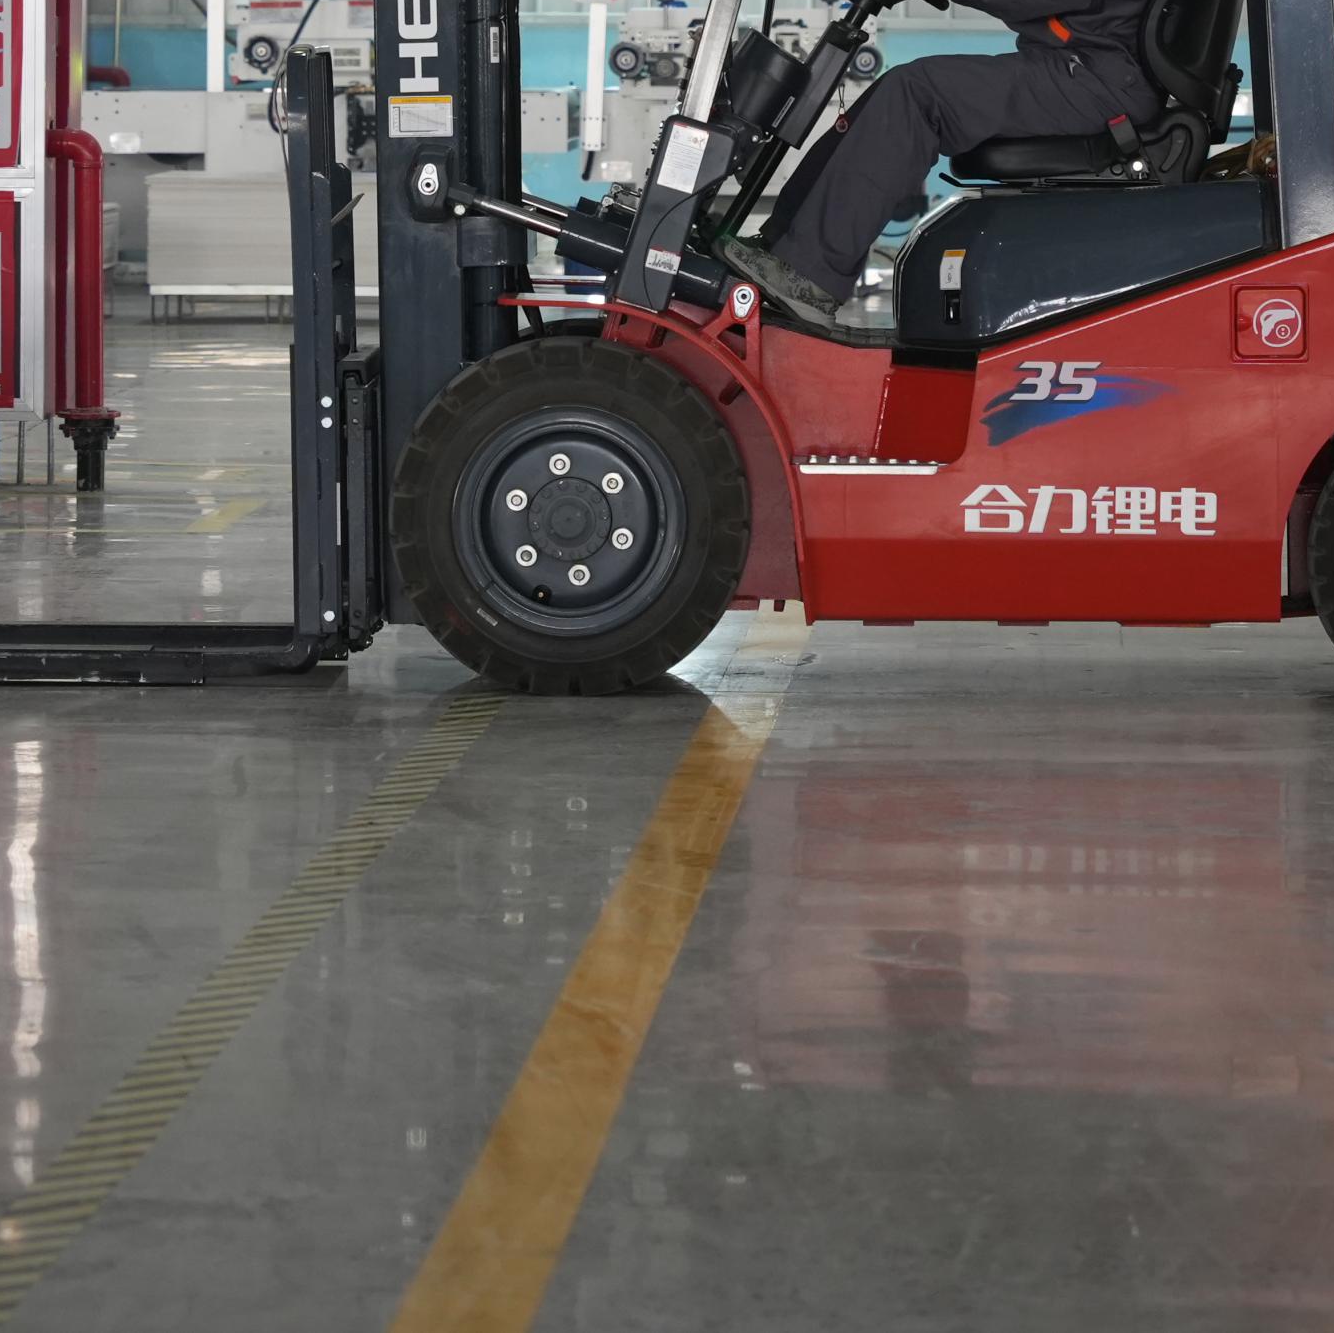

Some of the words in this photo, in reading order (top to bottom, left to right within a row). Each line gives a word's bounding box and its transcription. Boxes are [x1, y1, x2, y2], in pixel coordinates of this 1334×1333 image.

[1009, 361, 1102, 401] 35
[960, 484, 1218, 536] 合力锂电
